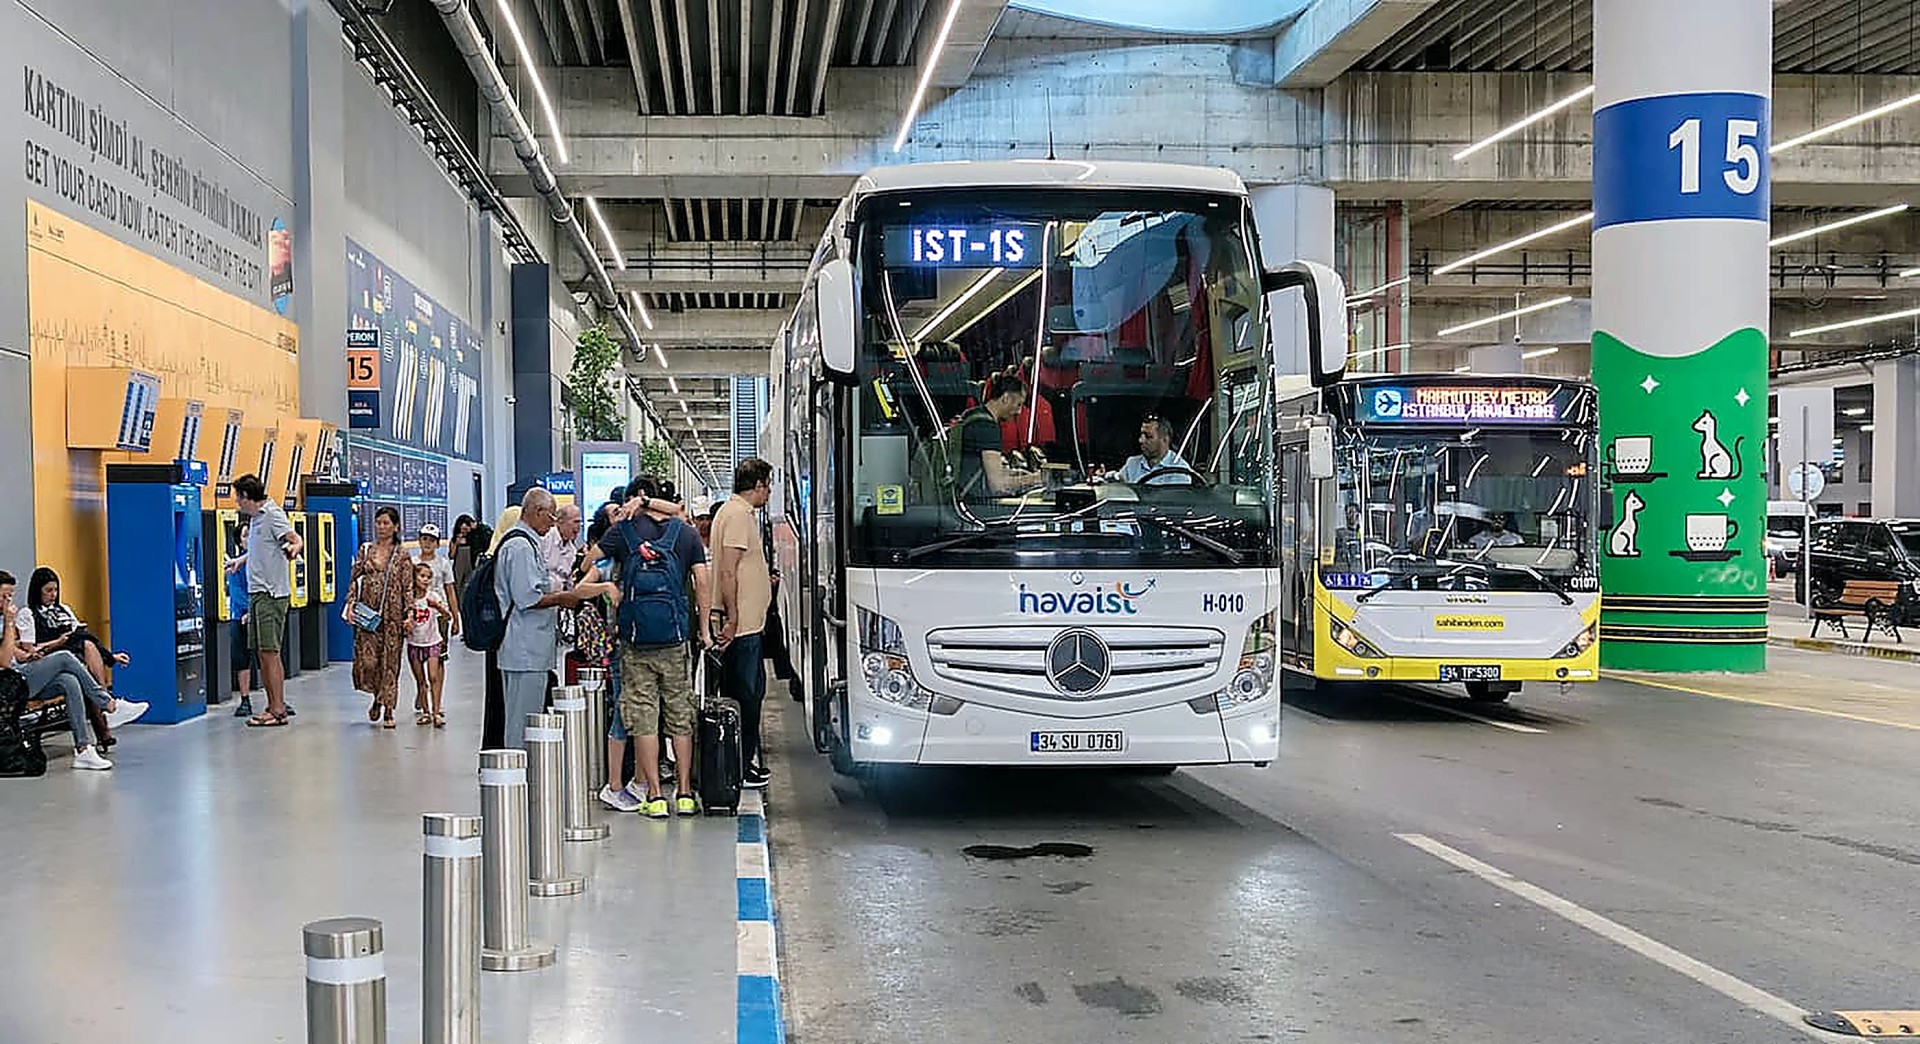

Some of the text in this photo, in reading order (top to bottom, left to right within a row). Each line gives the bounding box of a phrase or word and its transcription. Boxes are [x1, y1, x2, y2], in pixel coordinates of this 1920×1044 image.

[24, 65, 86, 145] KARTINI
[89, 103, 128, 170] ŞİMDİ
[131, 135, 149, 187] AL,
[151, 148, 190, 208] ŞEHRİN
[1668, 118, 1760, 196] 15
[25, 139, 49, 187] GET
[52, 154, 85, 207] YOUR
[88, 174, 117, 221] CARD
[119, 189, 145, 239] NOW,
[147, 205, 178, 254] CATCH
[178, 222, 195, 261] THE
[347, 356, 373, 380] 15
[1502, 388, 1548, 404] METRO
[1019, 582, 1139, 614] havaist
[1436, 617, 1503, 628] sahibinden.com
[1447, 667, 1458, 678] 34
[1476, 667, 1499, 678] 5300
[1040, 733, 1120, 749] 34 SU 0761
